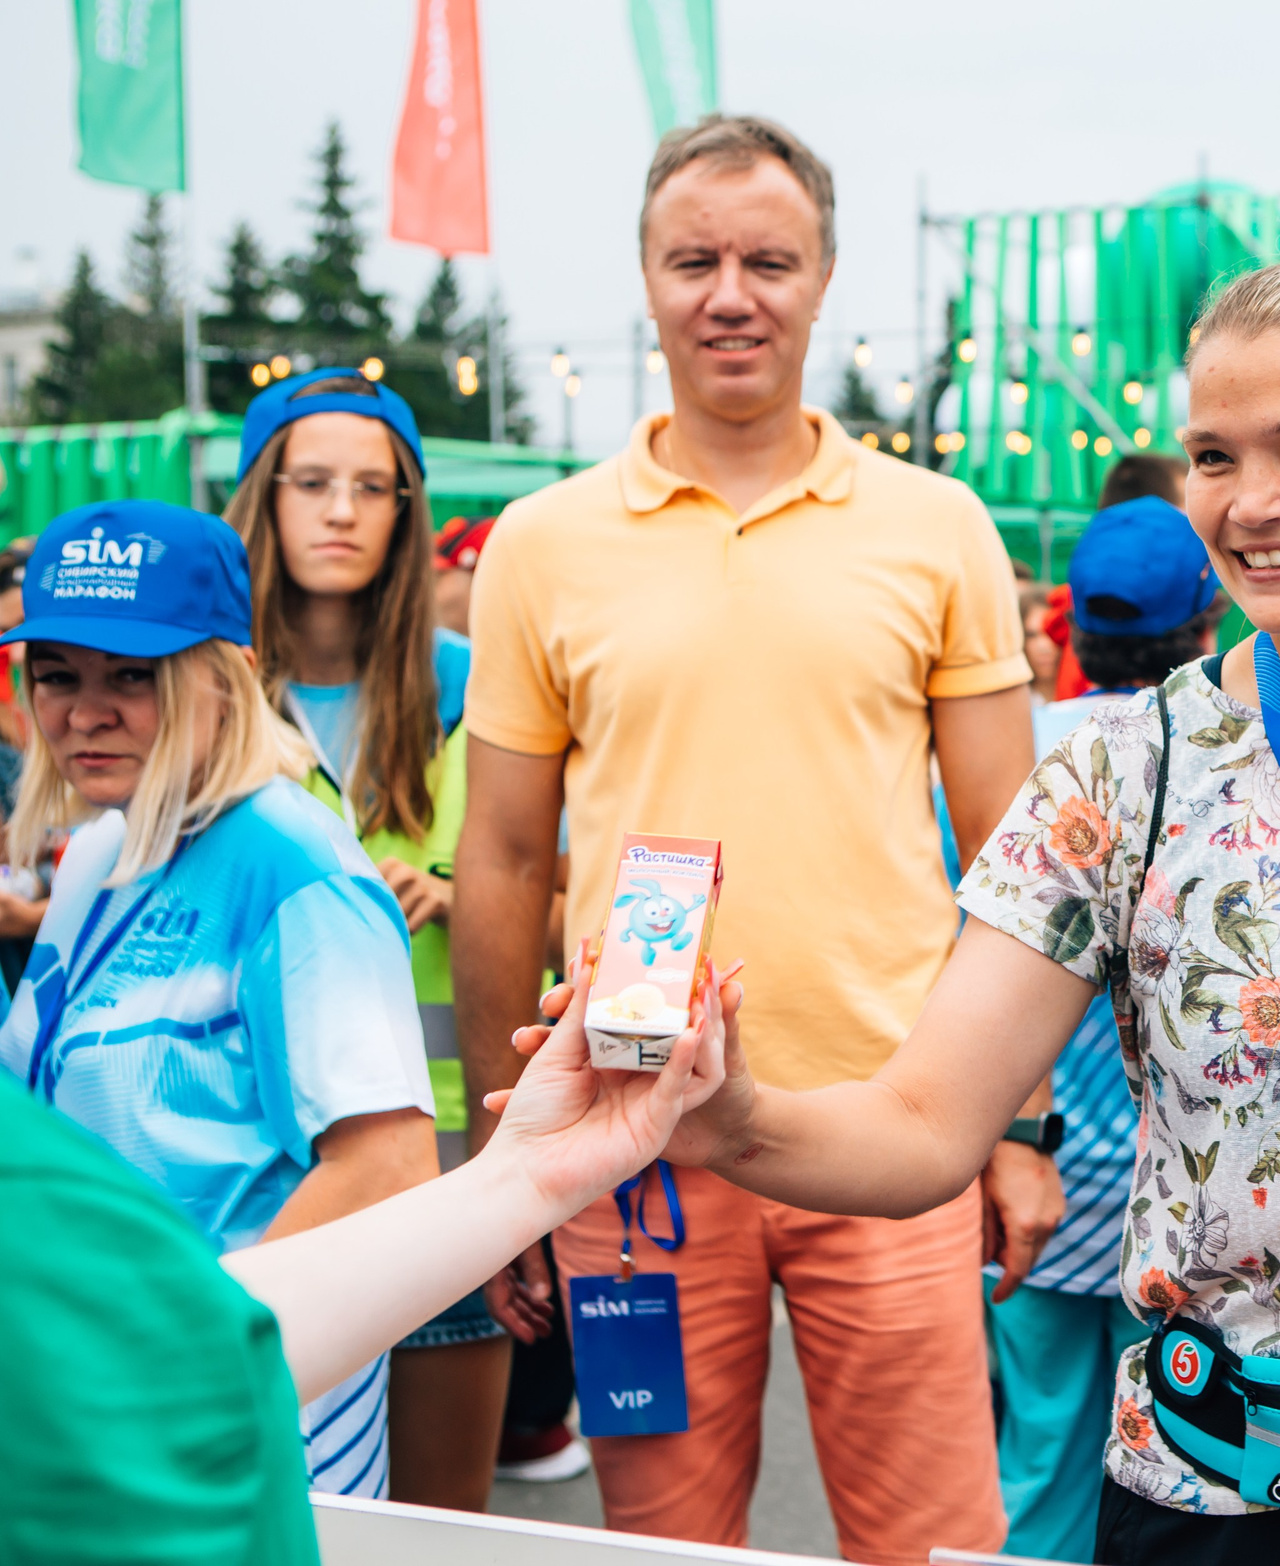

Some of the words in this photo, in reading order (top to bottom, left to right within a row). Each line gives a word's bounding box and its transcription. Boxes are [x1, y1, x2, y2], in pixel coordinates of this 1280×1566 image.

[57, 566, 139, 579] СИБИРСКИЙ
[53, 585, 137, 601] МАРАФОН
[631, 847, 706, 867] Растишка
[608, 1389, 653, 1410] VIP
